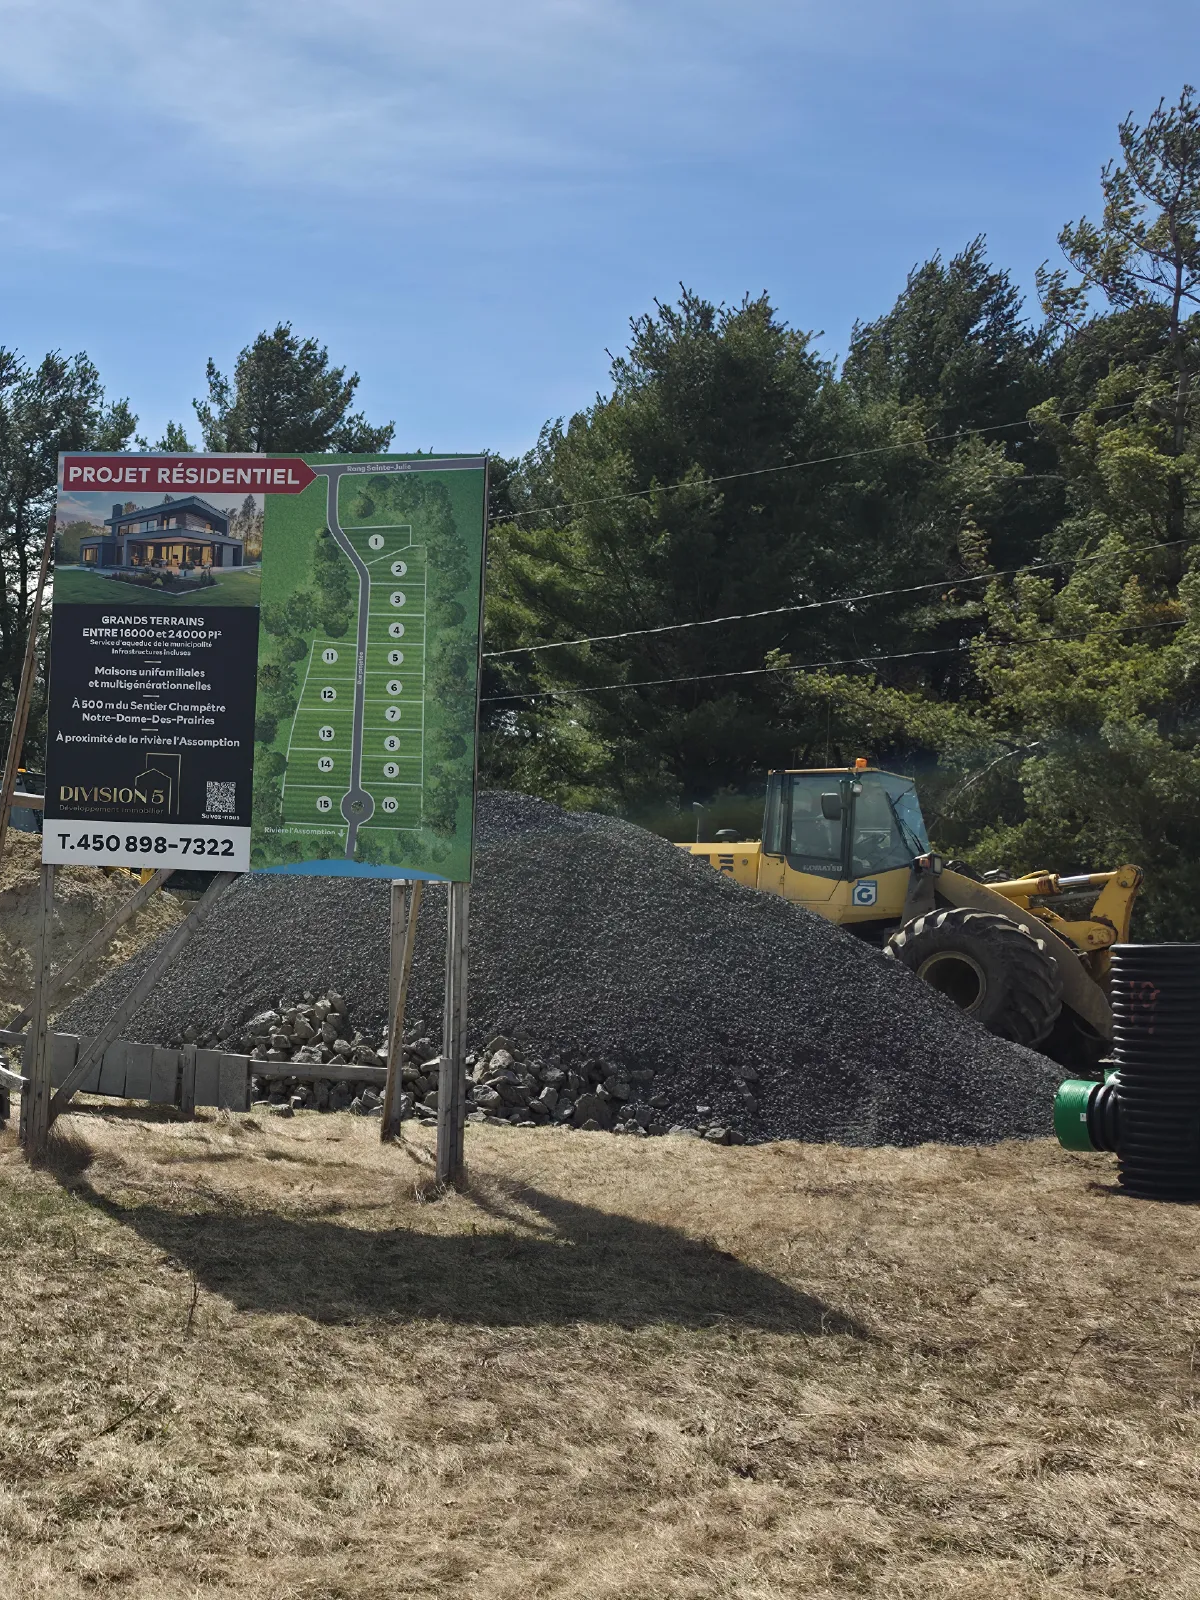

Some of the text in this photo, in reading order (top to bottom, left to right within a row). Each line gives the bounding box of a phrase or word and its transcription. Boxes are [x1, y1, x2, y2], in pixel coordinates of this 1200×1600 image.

[366, 463, 412, 472] Sainte-Julie
[69, 462, 300, 485] PROJET RÉSIDENTIEL
[101, 616, 204, 626] GRANDS TERRAINS
[82, 628, 222, 639] ENTRE 16000 et 24000 PI²
[94, 666, 205, 677] Maisons unifamiliales
[88, 680, 211, 690] et multigénérationnelles
[323, 691, 333, 699] 12
[72, 697, 80, 709] À
[82, 700, 103, 709] 500
[116, 701, 128, 710] du
[130, 701, 167, 711] Sentier
[168, 702, 226, 713] Champêtre
[82, 713, 215, 725] Notre-Dame-Des-Prairies
[56, 731, 240, 748] À proximité de la rivière l'Assomption
[60, 786, 164, 804] DIVISION 5
[59, 804, 119, 813] Développement
[58, 834, 235, 856] T.450 898-7322
[857, 888, 872, 902] G
